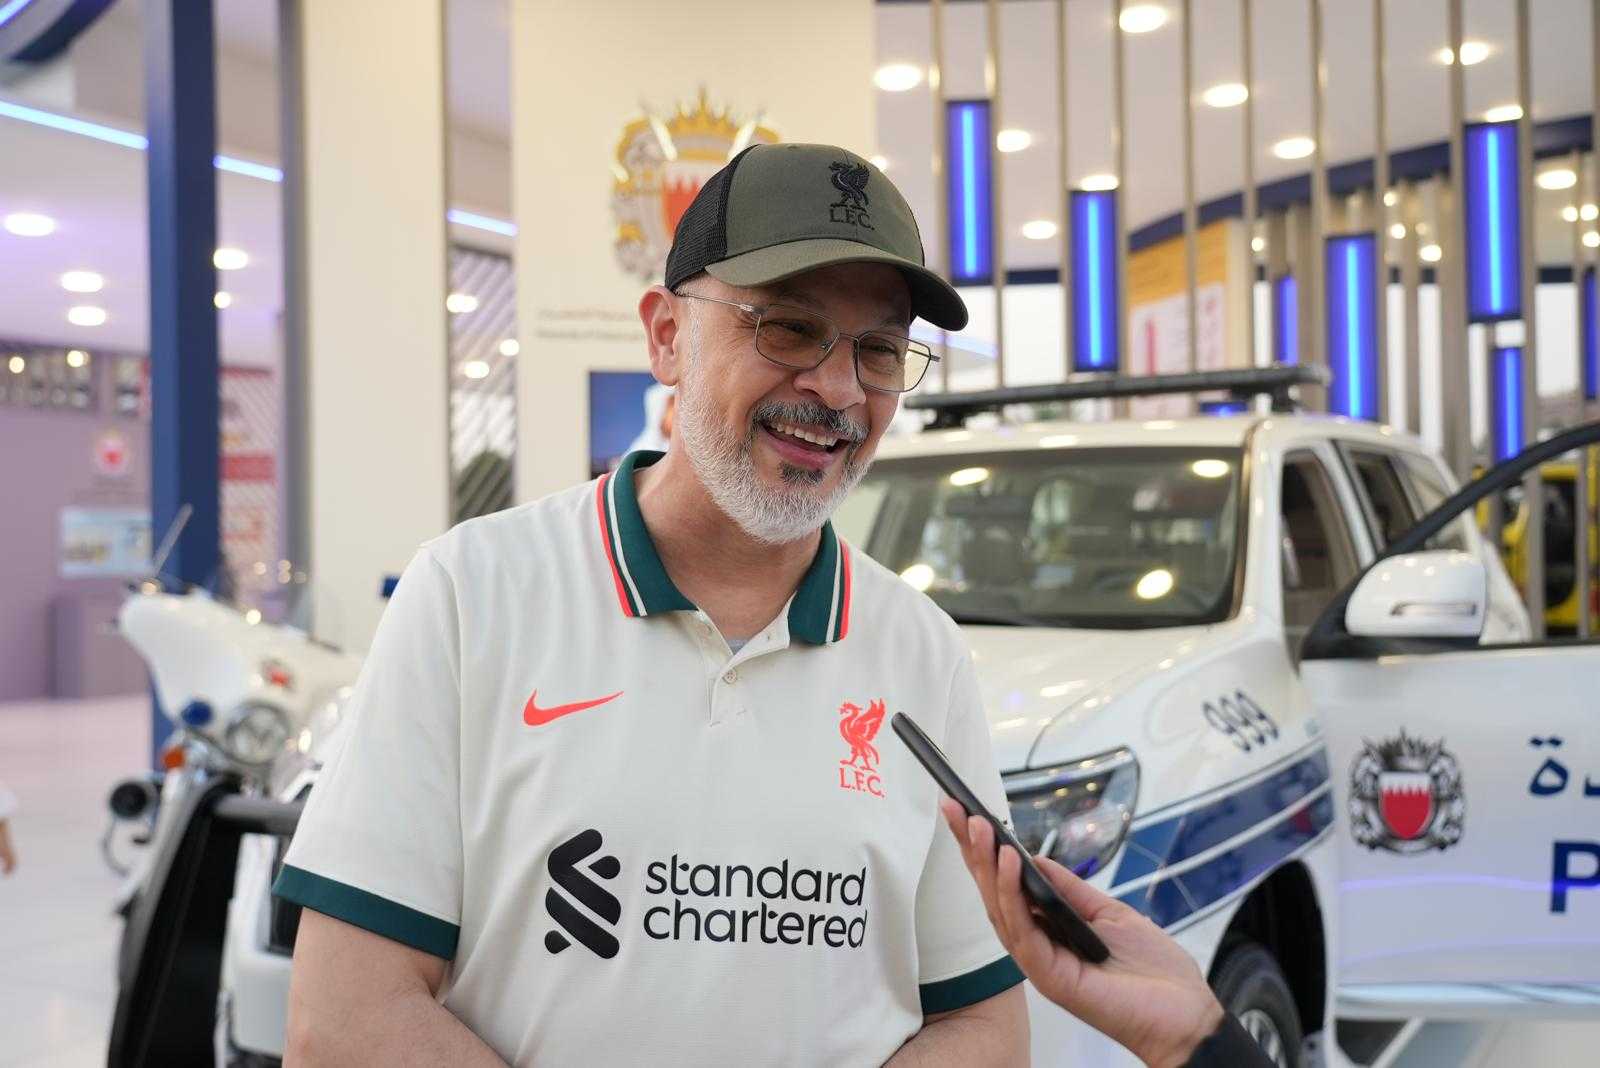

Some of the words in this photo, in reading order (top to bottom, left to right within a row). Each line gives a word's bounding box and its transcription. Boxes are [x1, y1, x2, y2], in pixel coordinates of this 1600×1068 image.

[829, 208, 875, 231] L.F.C.
[1203, 690, 1279, 751] 999
[840, 767, 885, 798] L.F.C.
[645, 853, 867, 906] standard
[643, 898, 868, 949] chartered
